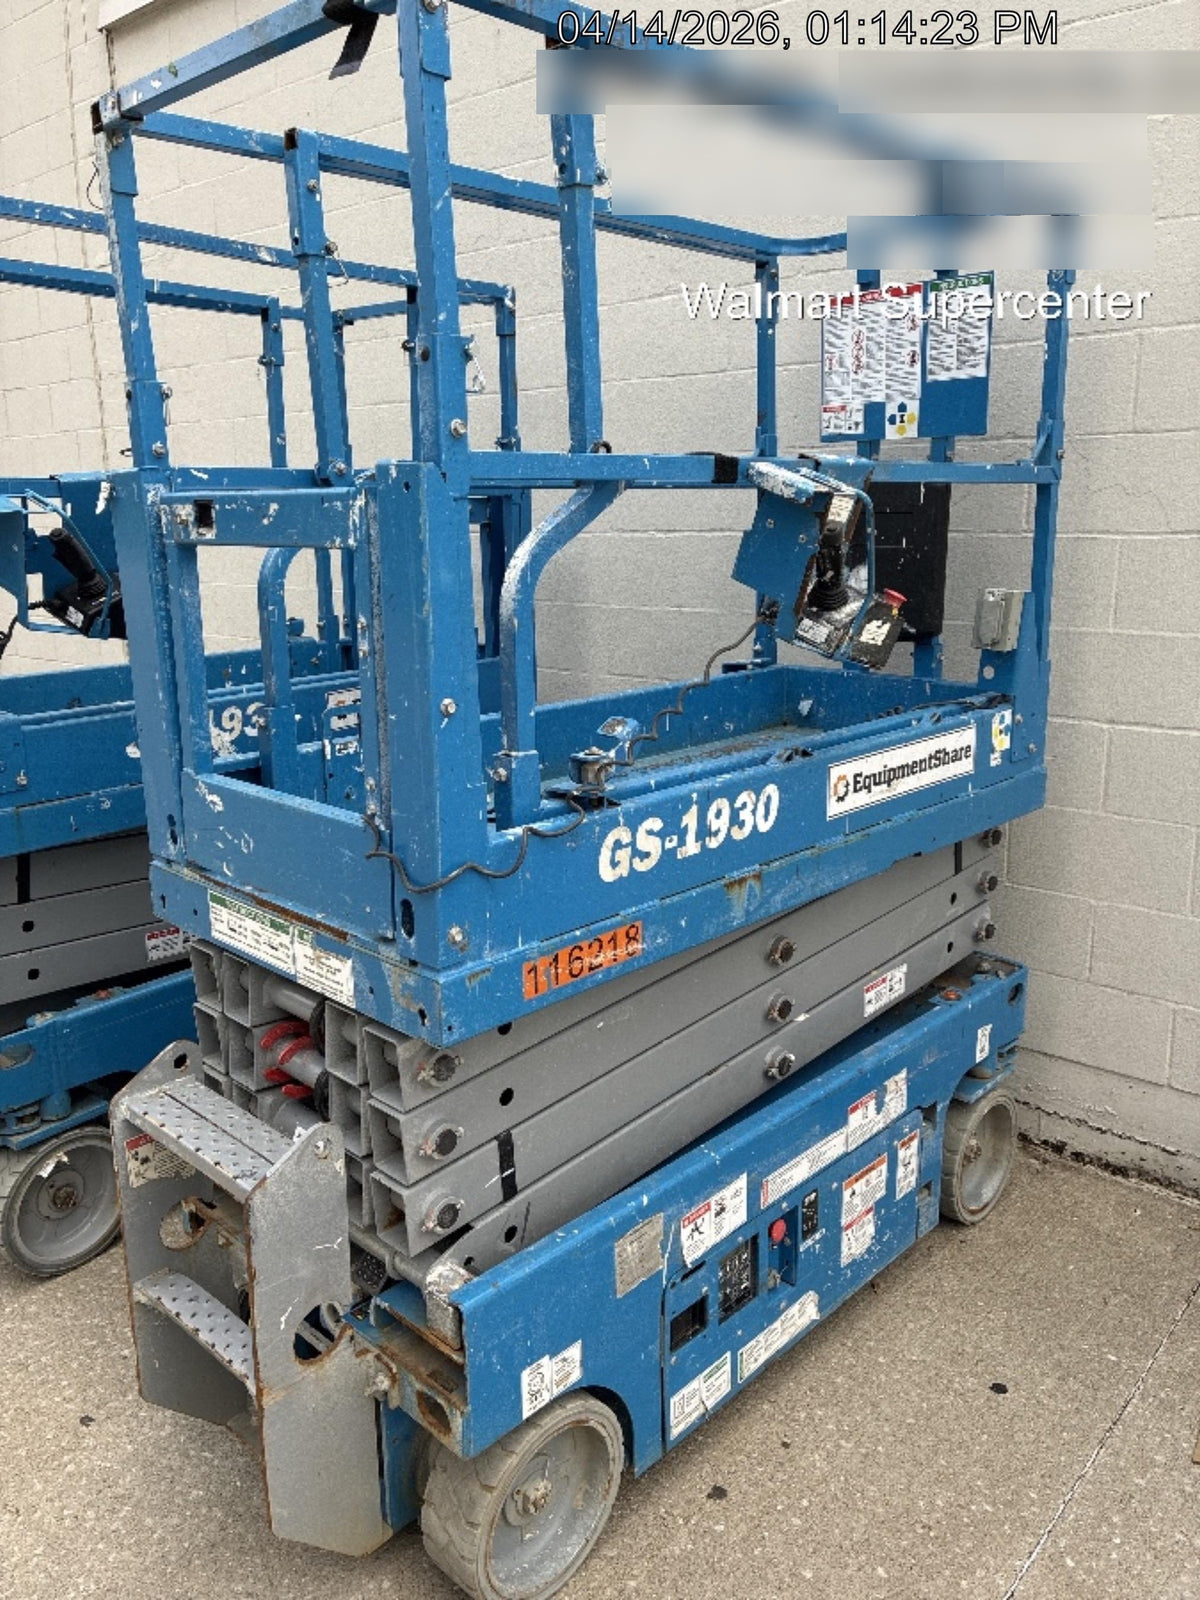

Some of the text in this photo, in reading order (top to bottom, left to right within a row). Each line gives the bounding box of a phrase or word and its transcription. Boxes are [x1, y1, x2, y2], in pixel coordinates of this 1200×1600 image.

[852, 744, 972, 793] EquipmentShare
[598, 783, 780, 883] GS-1930
[527, 924, 640, 994] 116218
